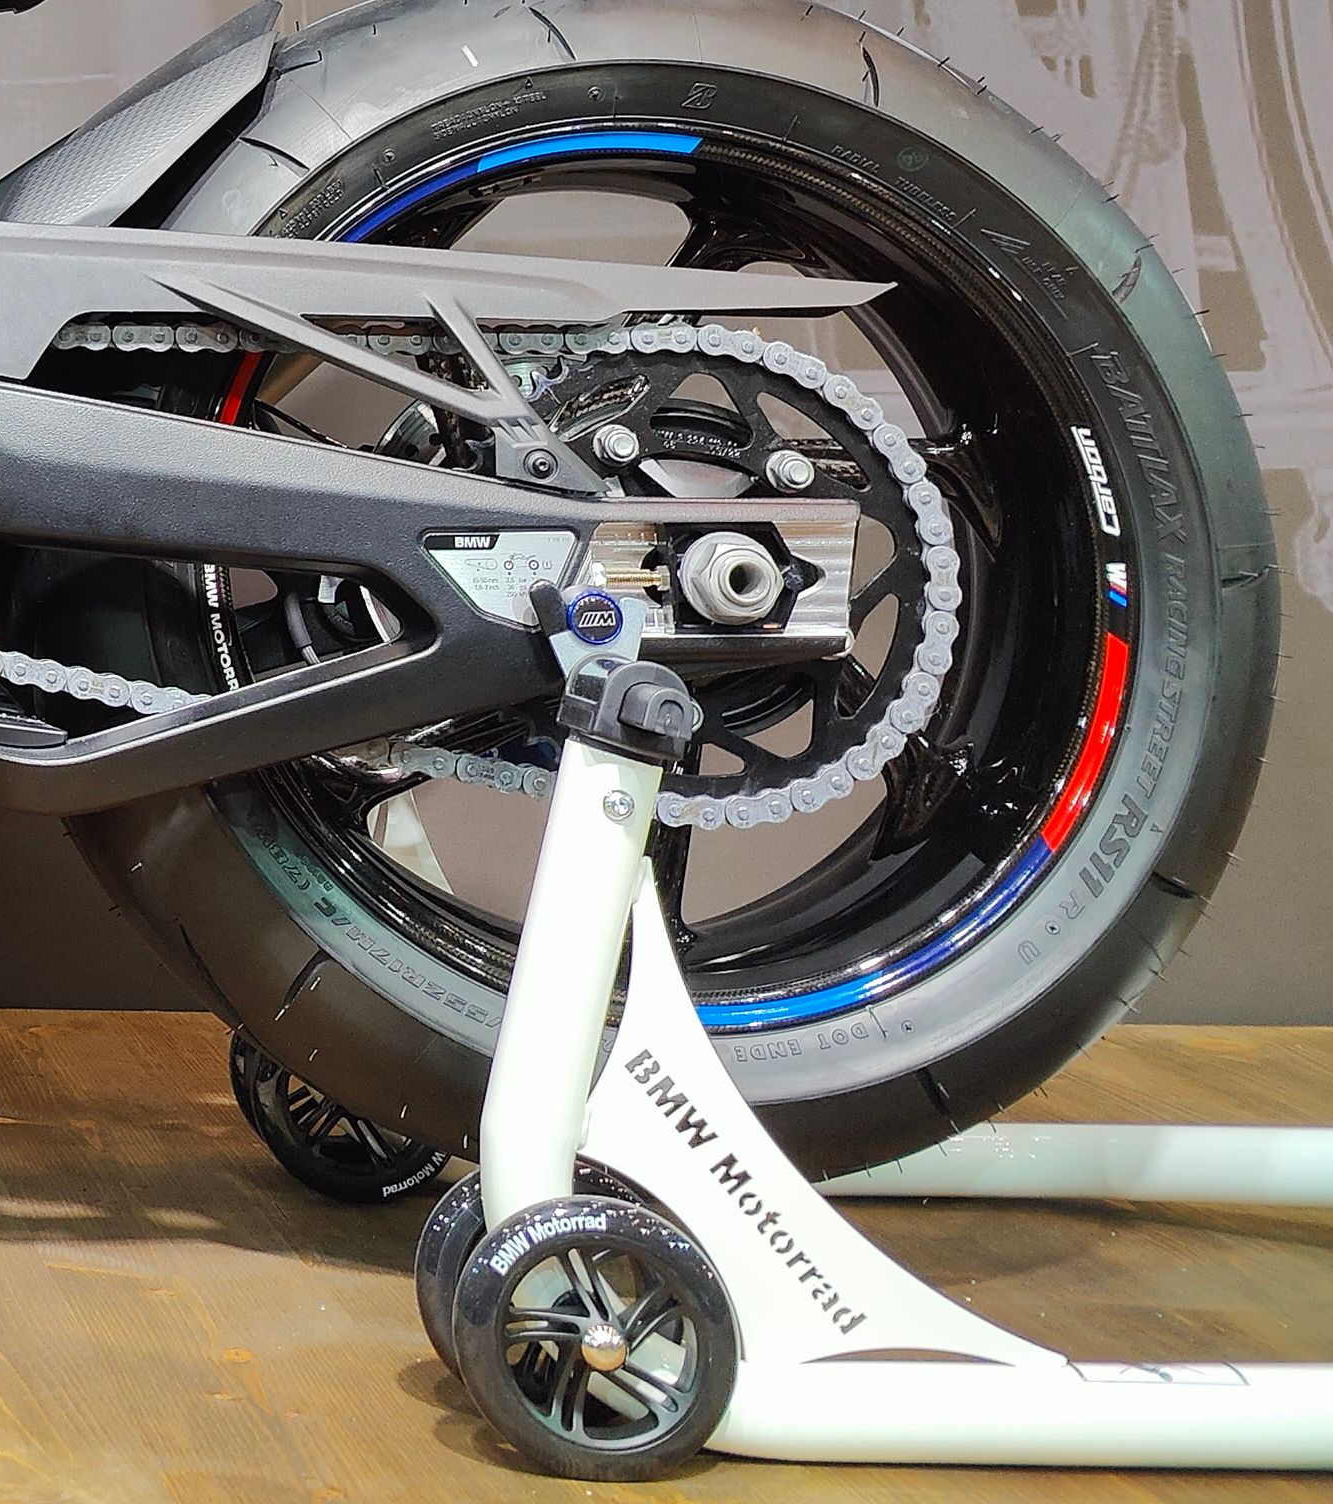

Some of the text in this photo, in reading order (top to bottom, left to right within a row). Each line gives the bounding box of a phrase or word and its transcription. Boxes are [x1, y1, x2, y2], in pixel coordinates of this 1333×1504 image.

[1070, 425, 1121, 537] Carbon
[454, 536, 491, 549] BMW
[204, 564, 240, 691] BMW MOTORR
[1136, 679, 1181, 798] STREET
[734, 1021, 869, 1064] DOT ENDE
[382, 1161, 436, 1198] Motorrad
[624, 1048, 868, 1335] BMW Motorrad
[489, 1213, 606, 1276] BMW Motorrad
